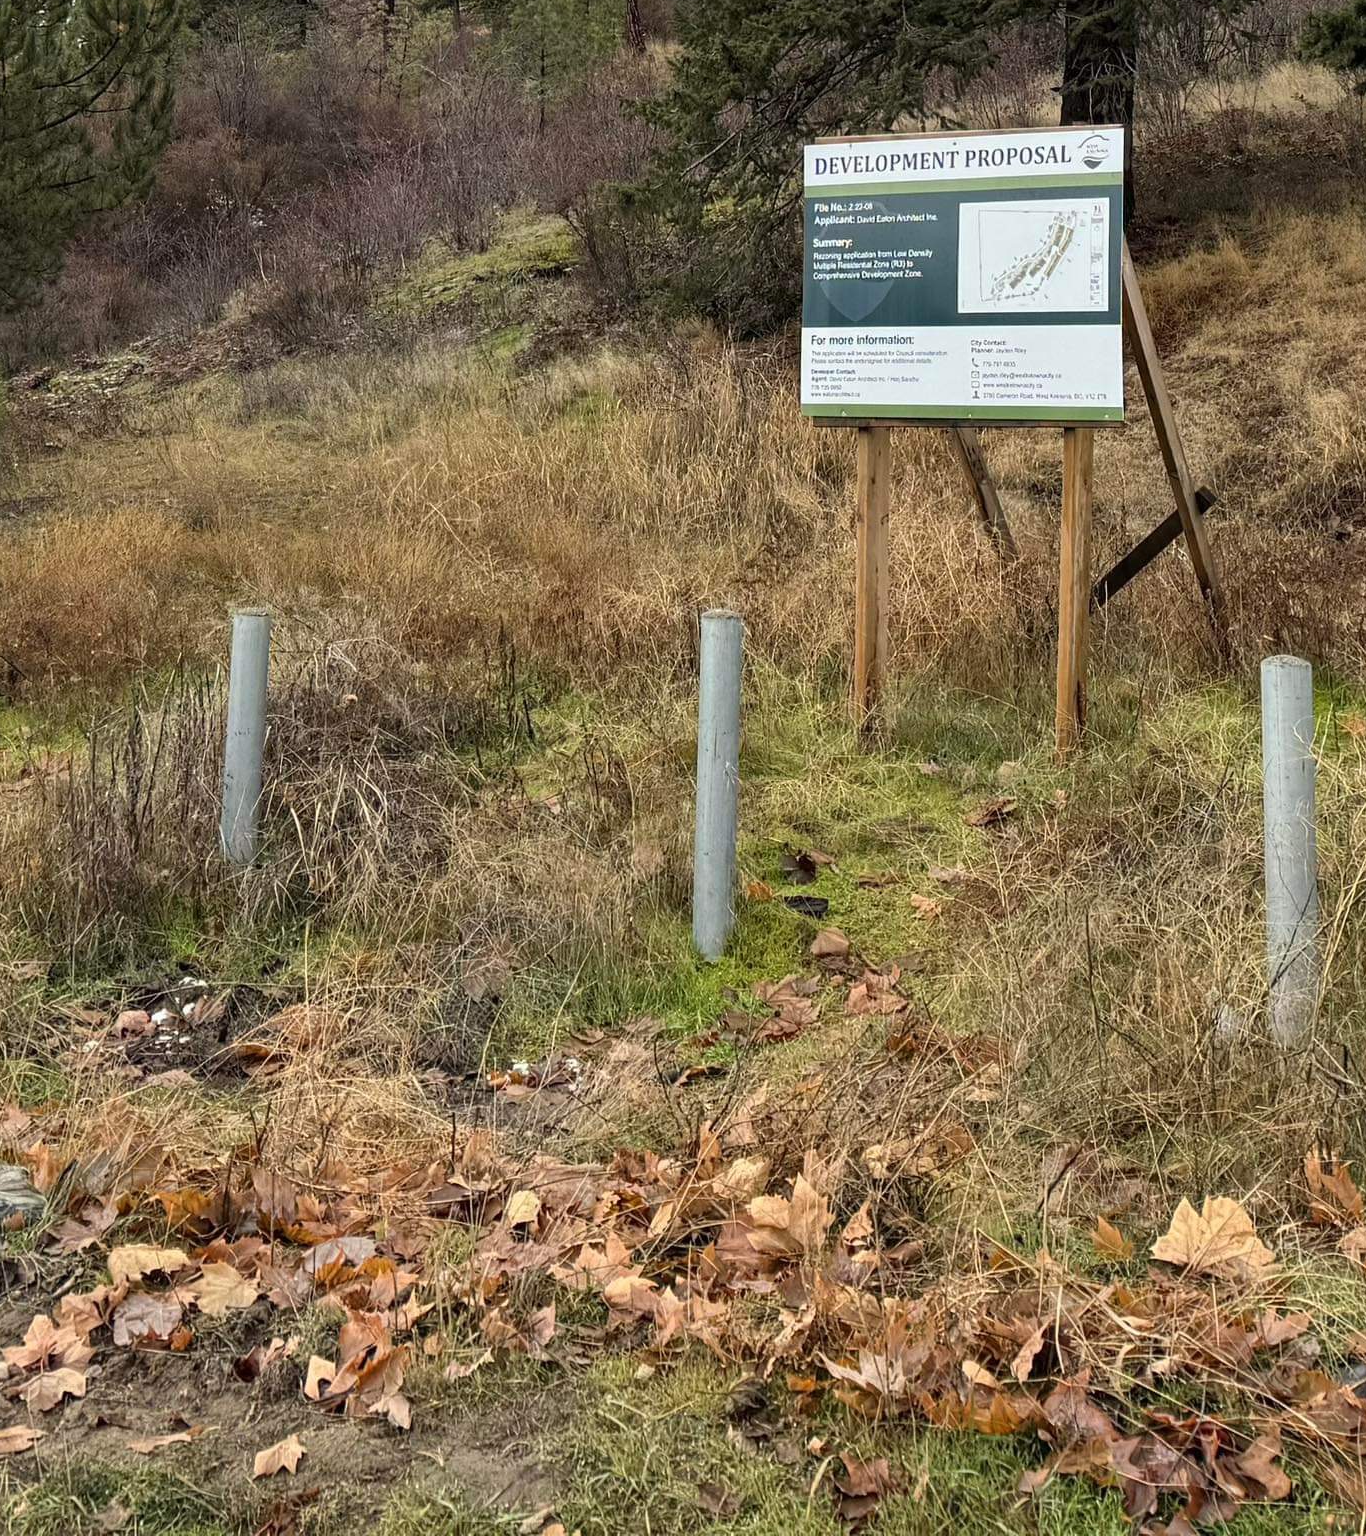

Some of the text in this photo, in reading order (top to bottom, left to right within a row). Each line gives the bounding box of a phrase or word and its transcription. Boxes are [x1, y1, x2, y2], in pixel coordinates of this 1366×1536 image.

[815, 145, 1072, 175] DEVELOPMENT PROPOSAL
[814, 204, 829, 213] File
[830, 203, 847, 212] No.:
[814, 214, 855, 227] Applicant:
[856, 214, 875, 224] David
[896, 213, 925, 222] Architect
[926, 213, 938, 221] Inc.
[813, 238, 853, 249] Summary:
[813, 252, 842, 261] Rezoning
[843, 252, 876, 261] application
[877, 250, 892, 258] from
[908, 249, 933, 259] Density
[813, 261, 836, 270] Multiple
[837, 261, 872, 269] Residential
[873, 260, 889, 268] Zone
[813, 269, 923, 281] Comprehensive Development Zone.
[811, 334, 915, 345] For more information:
[970, 339, 982, 347] City
